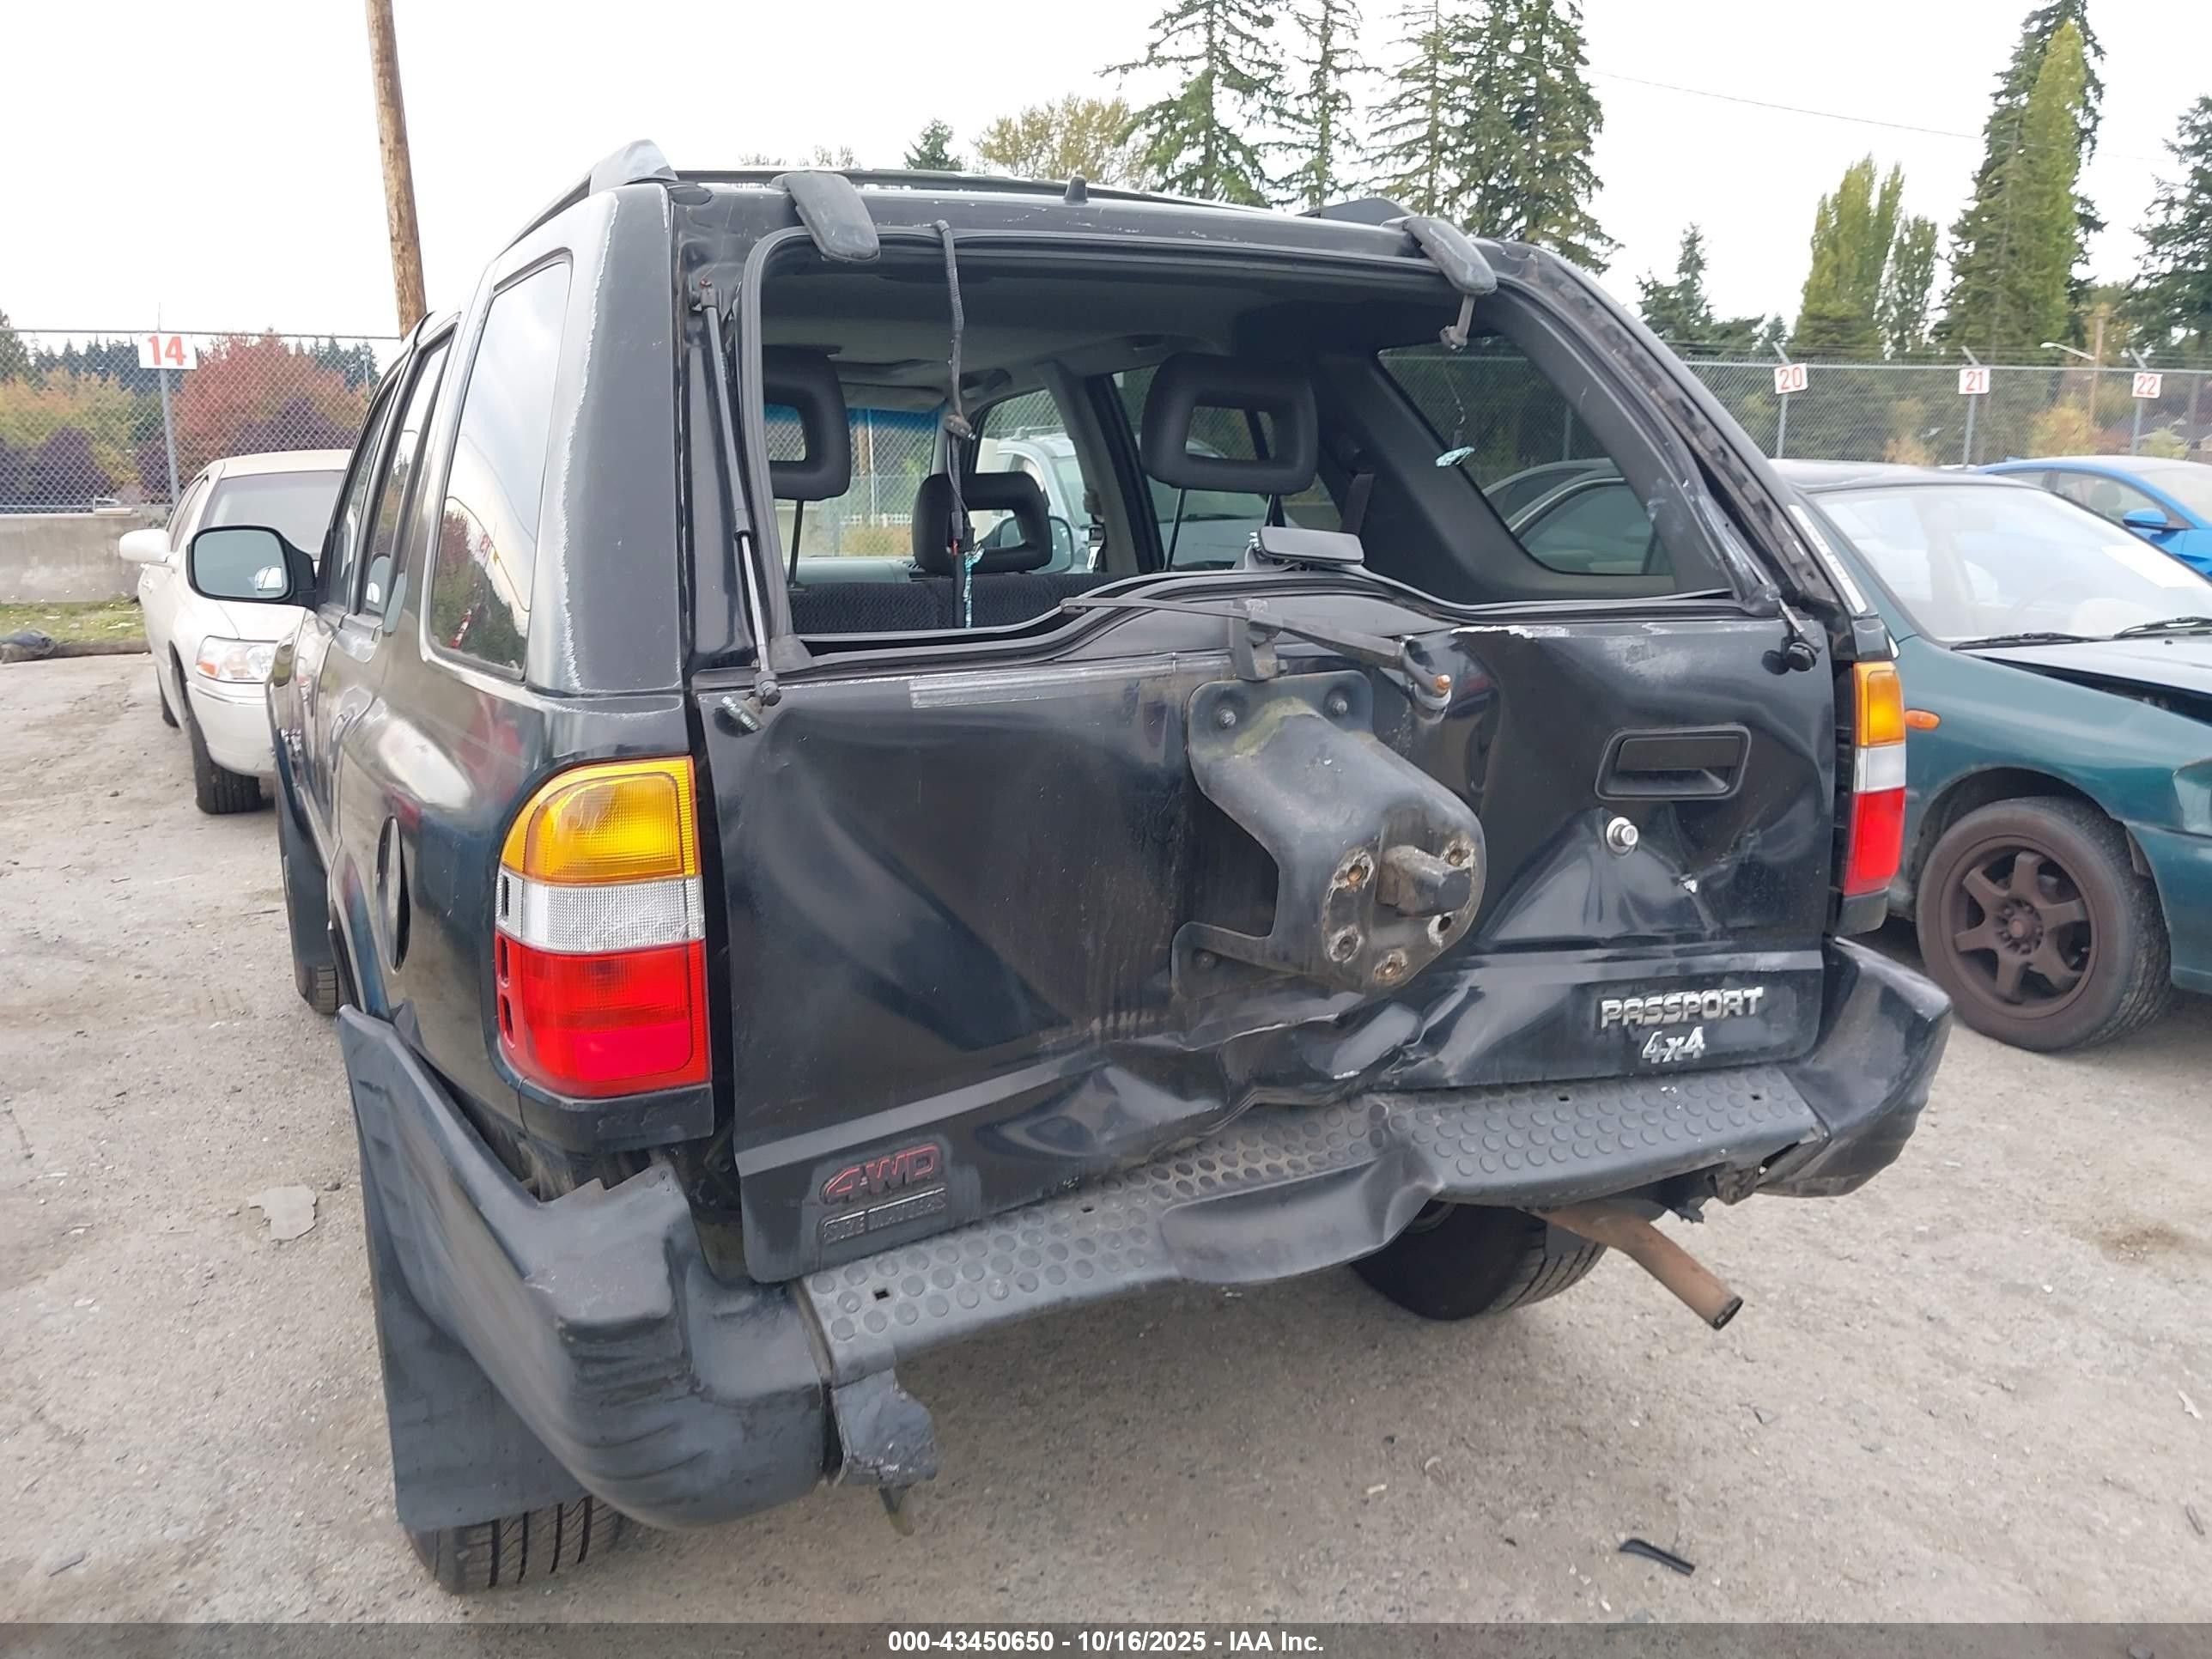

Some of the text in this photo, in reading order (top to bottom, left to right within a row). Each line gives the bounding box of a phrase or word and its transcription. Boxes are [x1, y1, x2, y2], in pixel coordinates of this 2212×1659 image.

[148, 336, 186, 366] 14
[1778, 367, 1802, 390] 20
[1966, 370, 1984, 392] 21
[2136, 374, 2157, 395] 22
[1601, 987, 1765, 1029] PASSPORT
[1642, 1026, 1706, 1064] 4x4
[821, 1143, 941, 1205] 4WD
